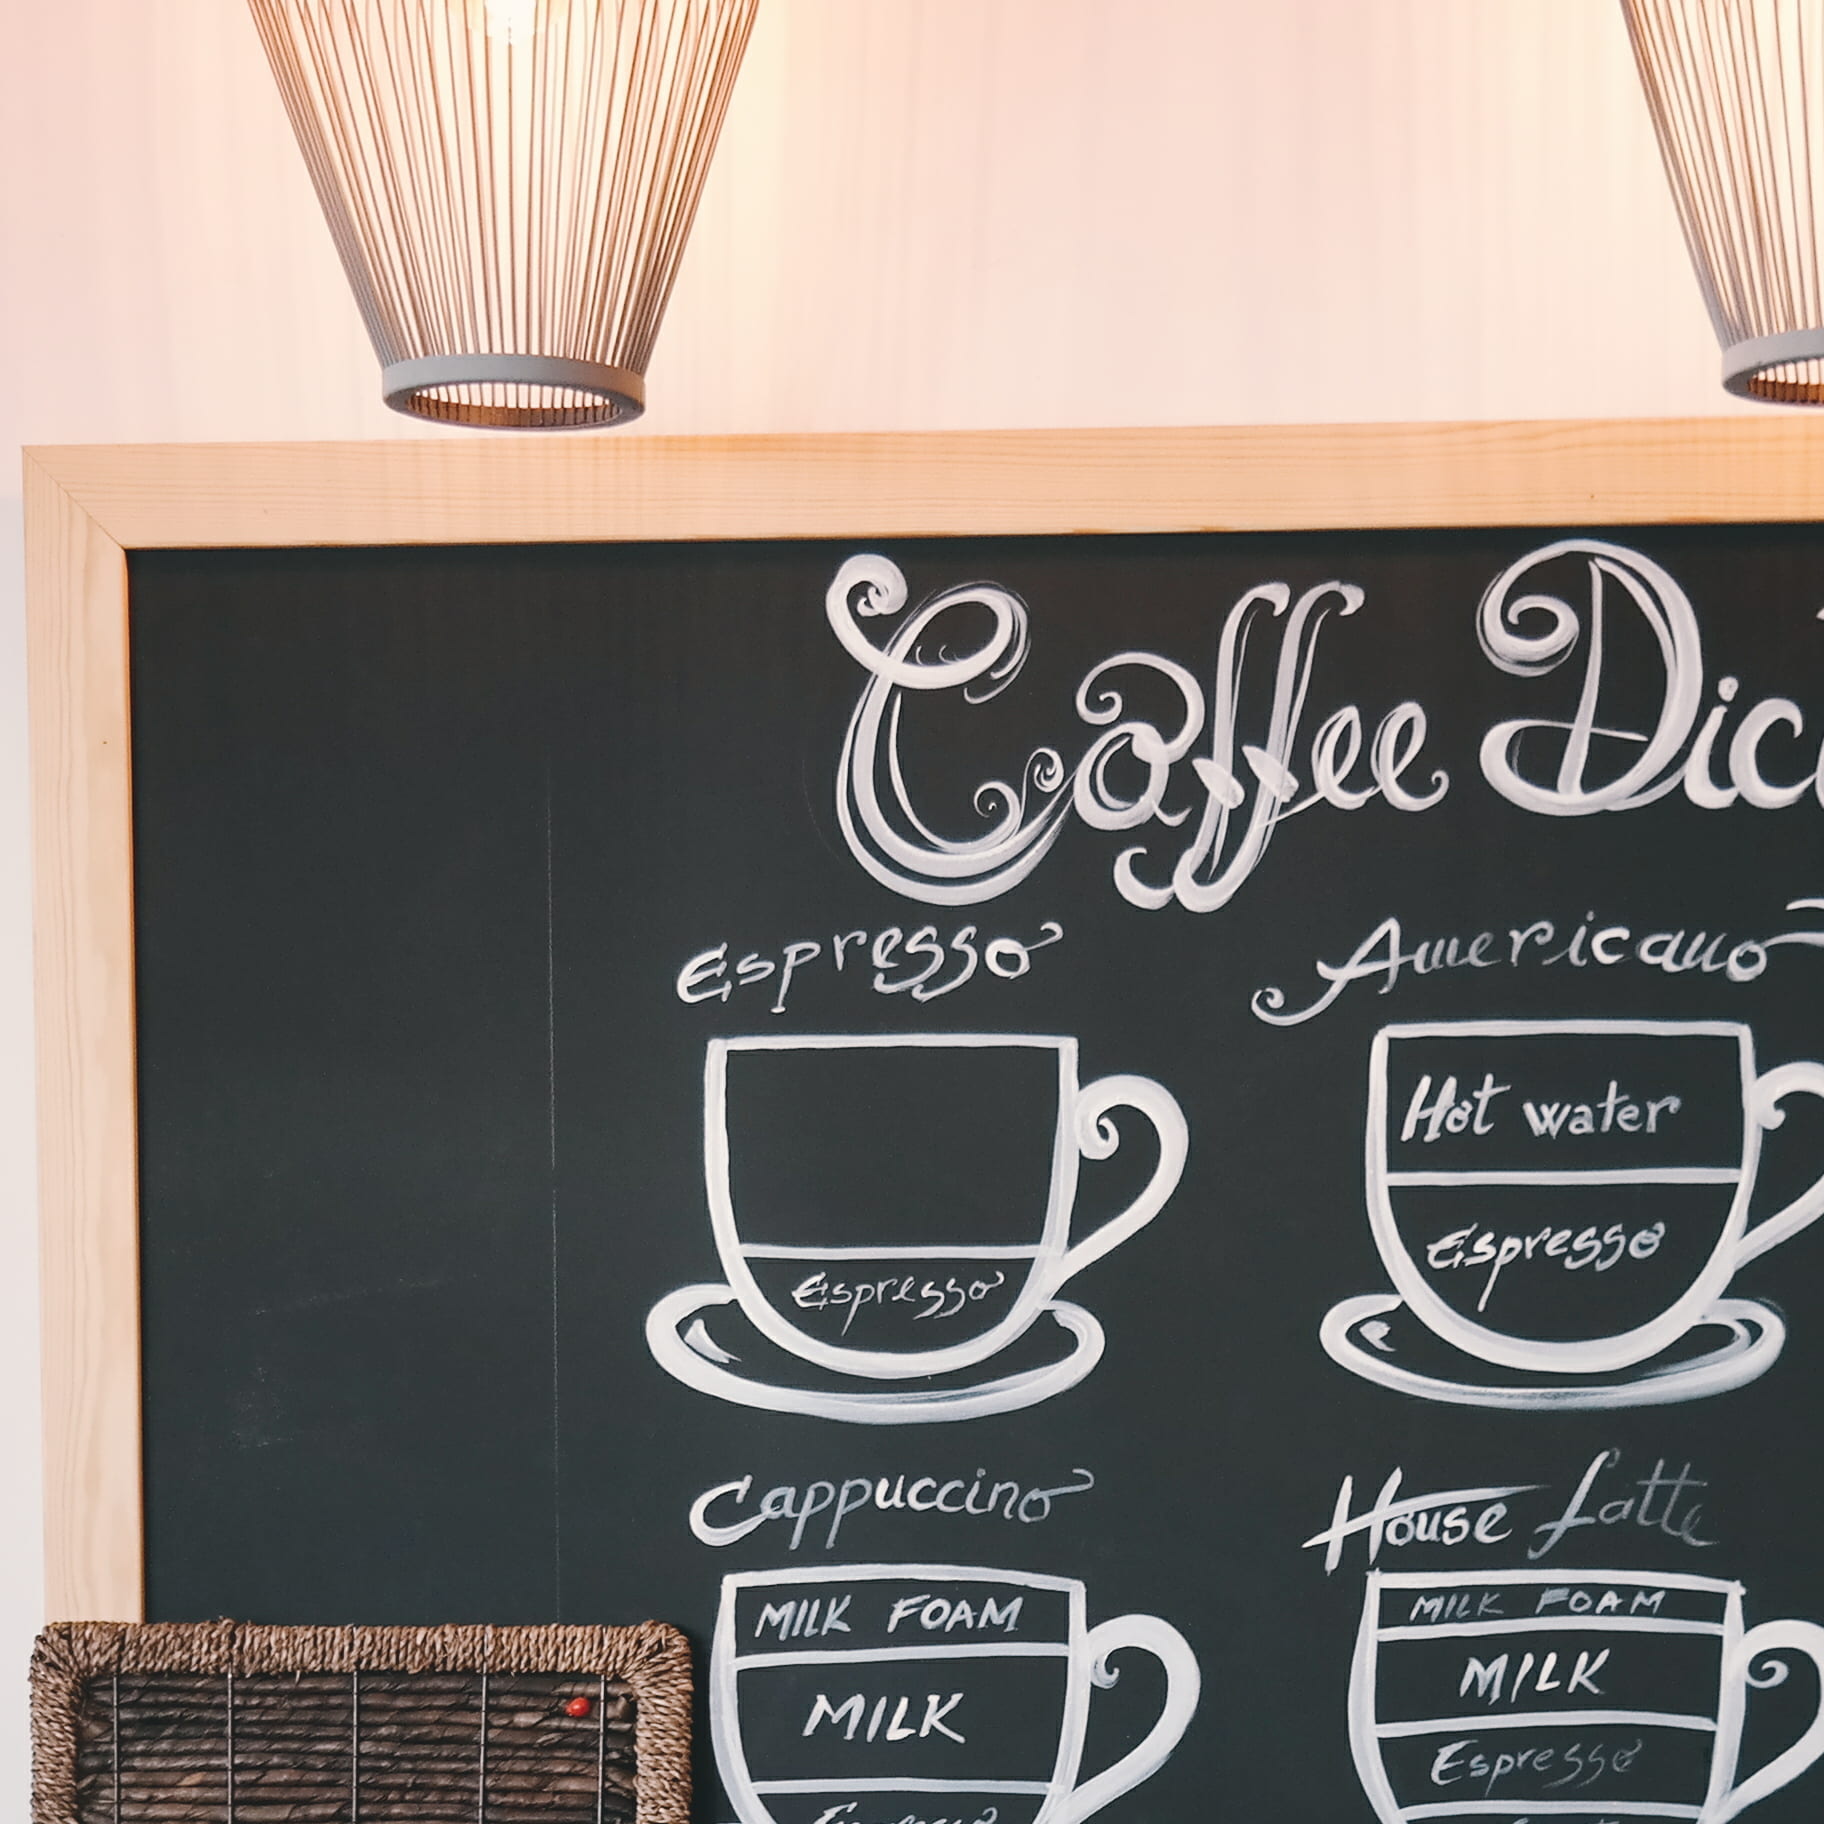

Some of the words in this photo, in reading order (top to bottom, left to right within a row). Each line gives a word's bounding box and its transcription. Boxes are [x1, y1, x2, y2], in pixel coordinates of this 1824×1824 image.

[826, 553, 1448, 911] Coffee
[677, 921, 1064, 1014] Espresso
[1401, 1073, 1511, 1143] Hot
[1523, 1080, 1681, 1139] water
[1426, 1222, 1666, 1313] Espresso
[791, 1271, 1005, 1337] Espresso
[688, 1469, 1094, 1550] Cappuccino
[1302, 1466, 1551, 1576] House
[1526, 1448, 1719, 1561] Latte
[754, 1595, 852, 1640] MILK
[887, 1593, 1024, 1634] FOAM
[1409, 1592, 1504, 1623] MILK
[1535, 1587, 1667, 1616] FOAM
[1459, 1648, 1611, 1706] MILK
[802, 1692, 967, 1744] MILK
[1429, 1738, 1644, 1797] Espresso
